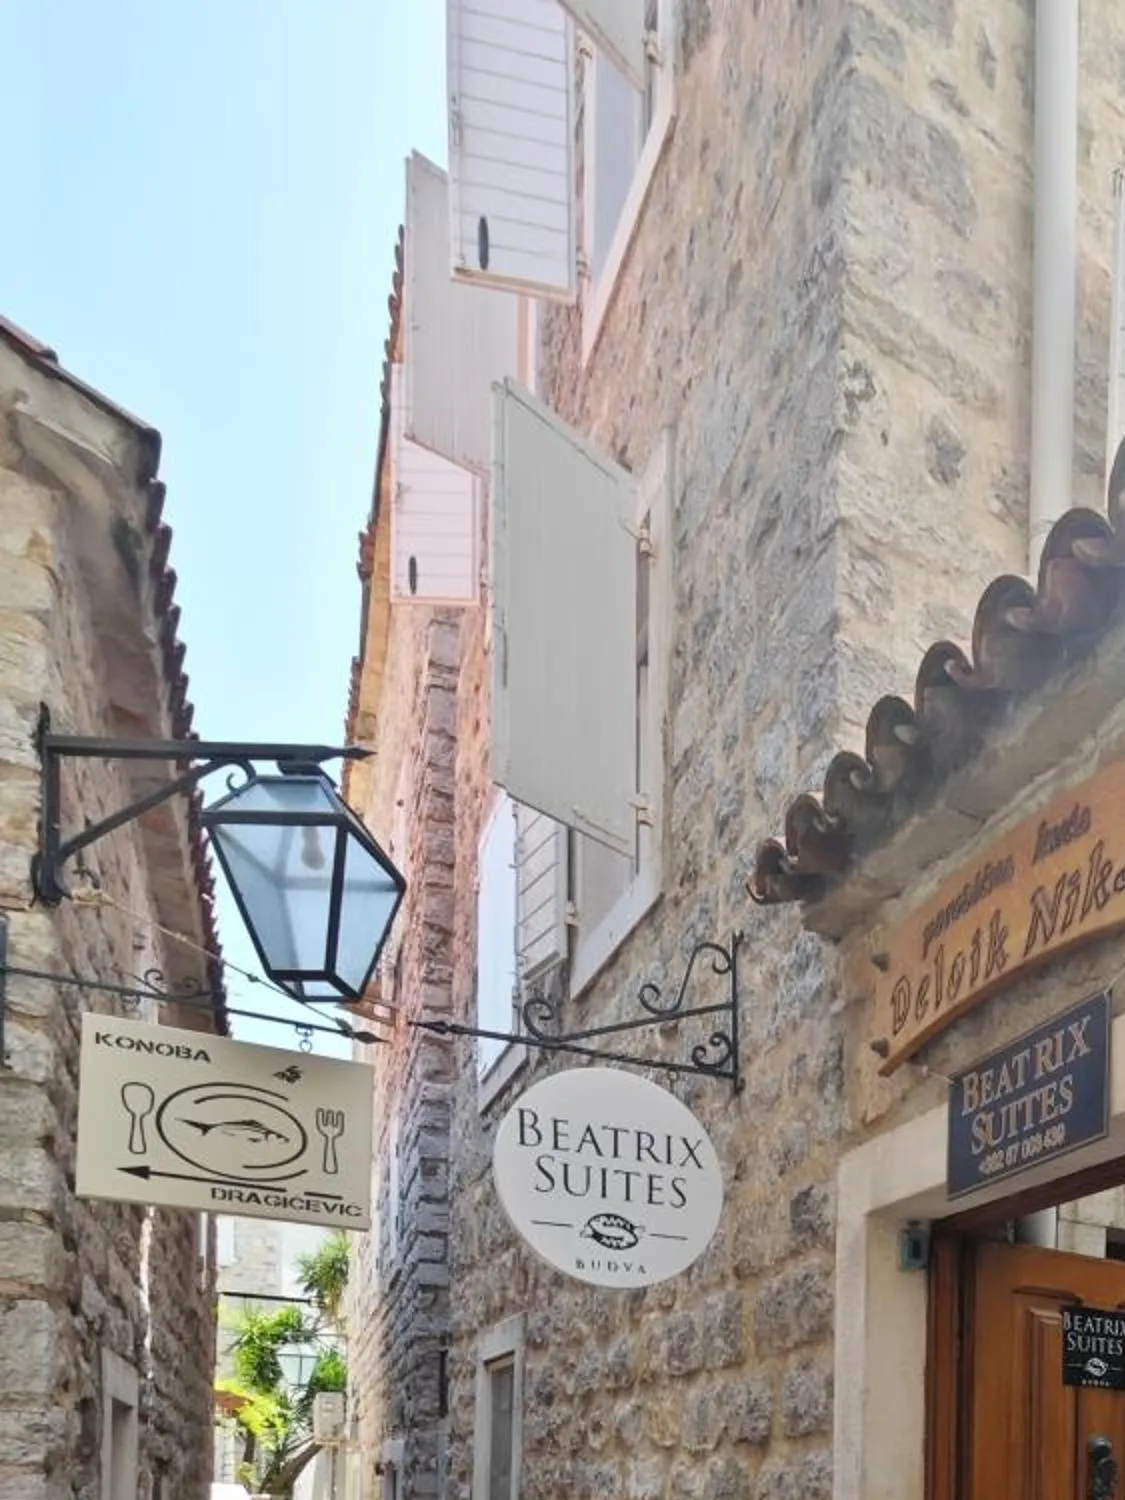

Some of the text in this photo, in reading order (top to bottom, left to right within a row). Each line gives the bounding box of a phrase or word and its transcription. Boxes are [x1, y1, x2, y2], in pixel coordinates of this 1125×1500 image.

[95, 1031, 211, 1063] KONOBA
[961, 1015, 1092, 1116] BEATRIX
[517, 1107, 704, 1169] BEATRIX
[971, 1073, 1074, 1155] SUITES
[535, 1153, 688, 1209] SUITES
[575, 1258, 648, 1275] BUDVA
[1066, 1331, 1123, 1356] SUITES
